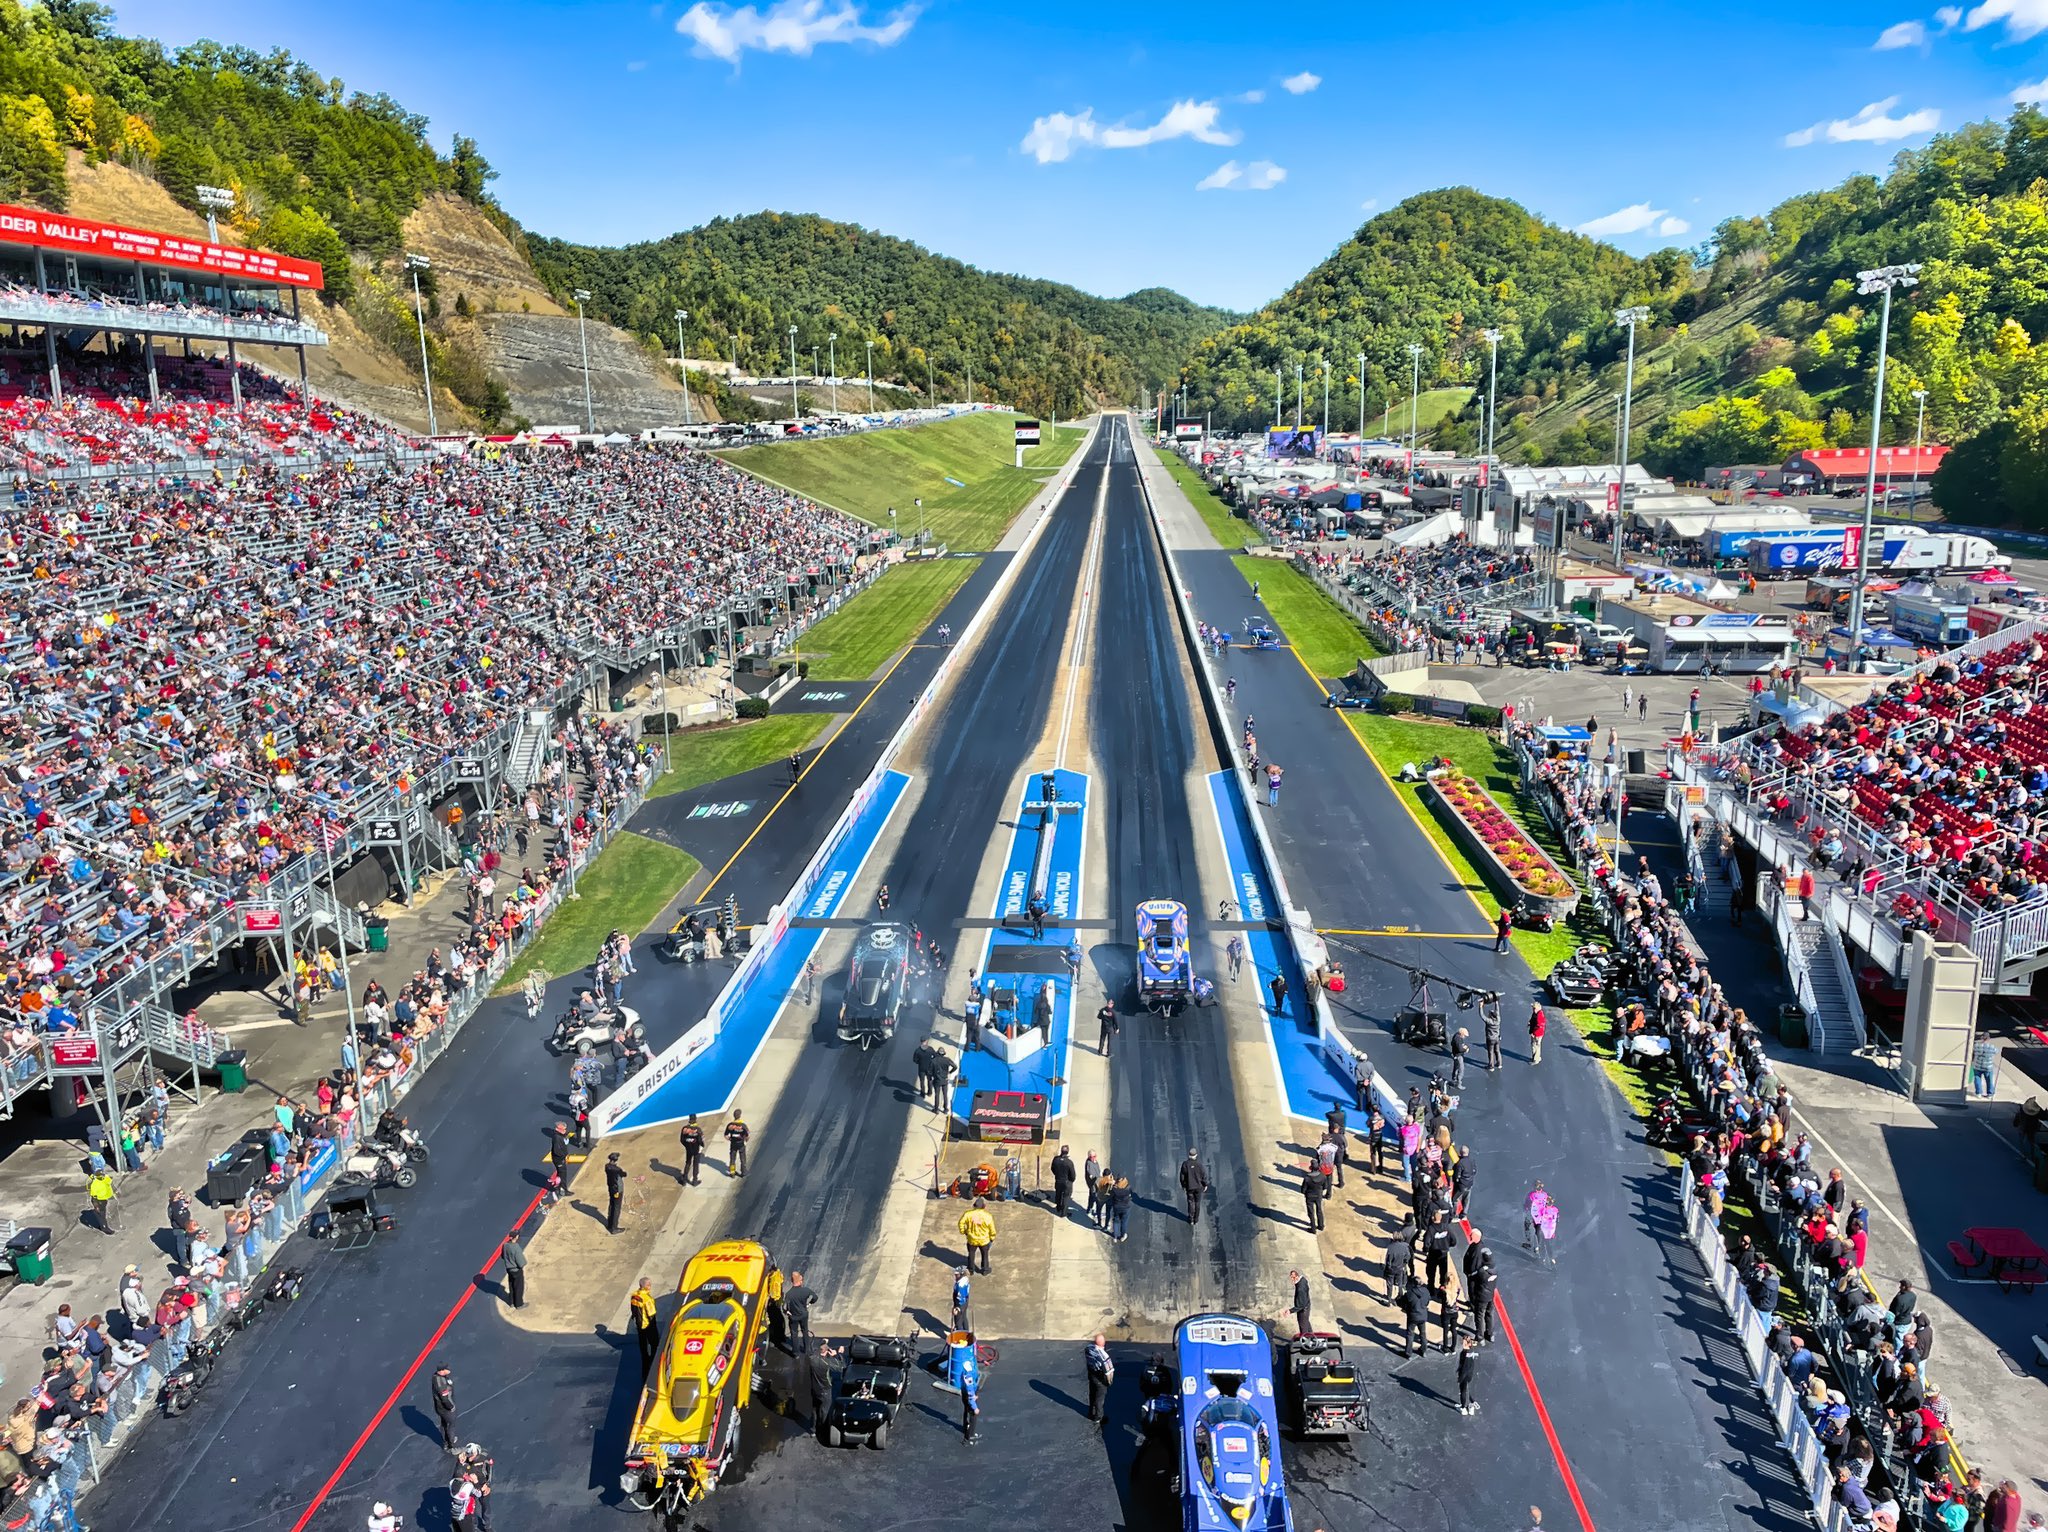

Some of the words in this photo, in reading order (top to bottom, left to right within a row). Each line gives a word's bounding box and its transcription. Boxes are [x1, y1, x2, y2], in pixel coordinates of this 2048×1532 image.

[42, 221, 99, 243] VALLEY
[1845, 555, 1857, 567] 3
[373, 828, 397, 839] F-G
[808, 889, 834, 918] CAMPING
[637, 1055, 682, 1098] BRISTOL
[705, 1254, 752, 1262] DHL
